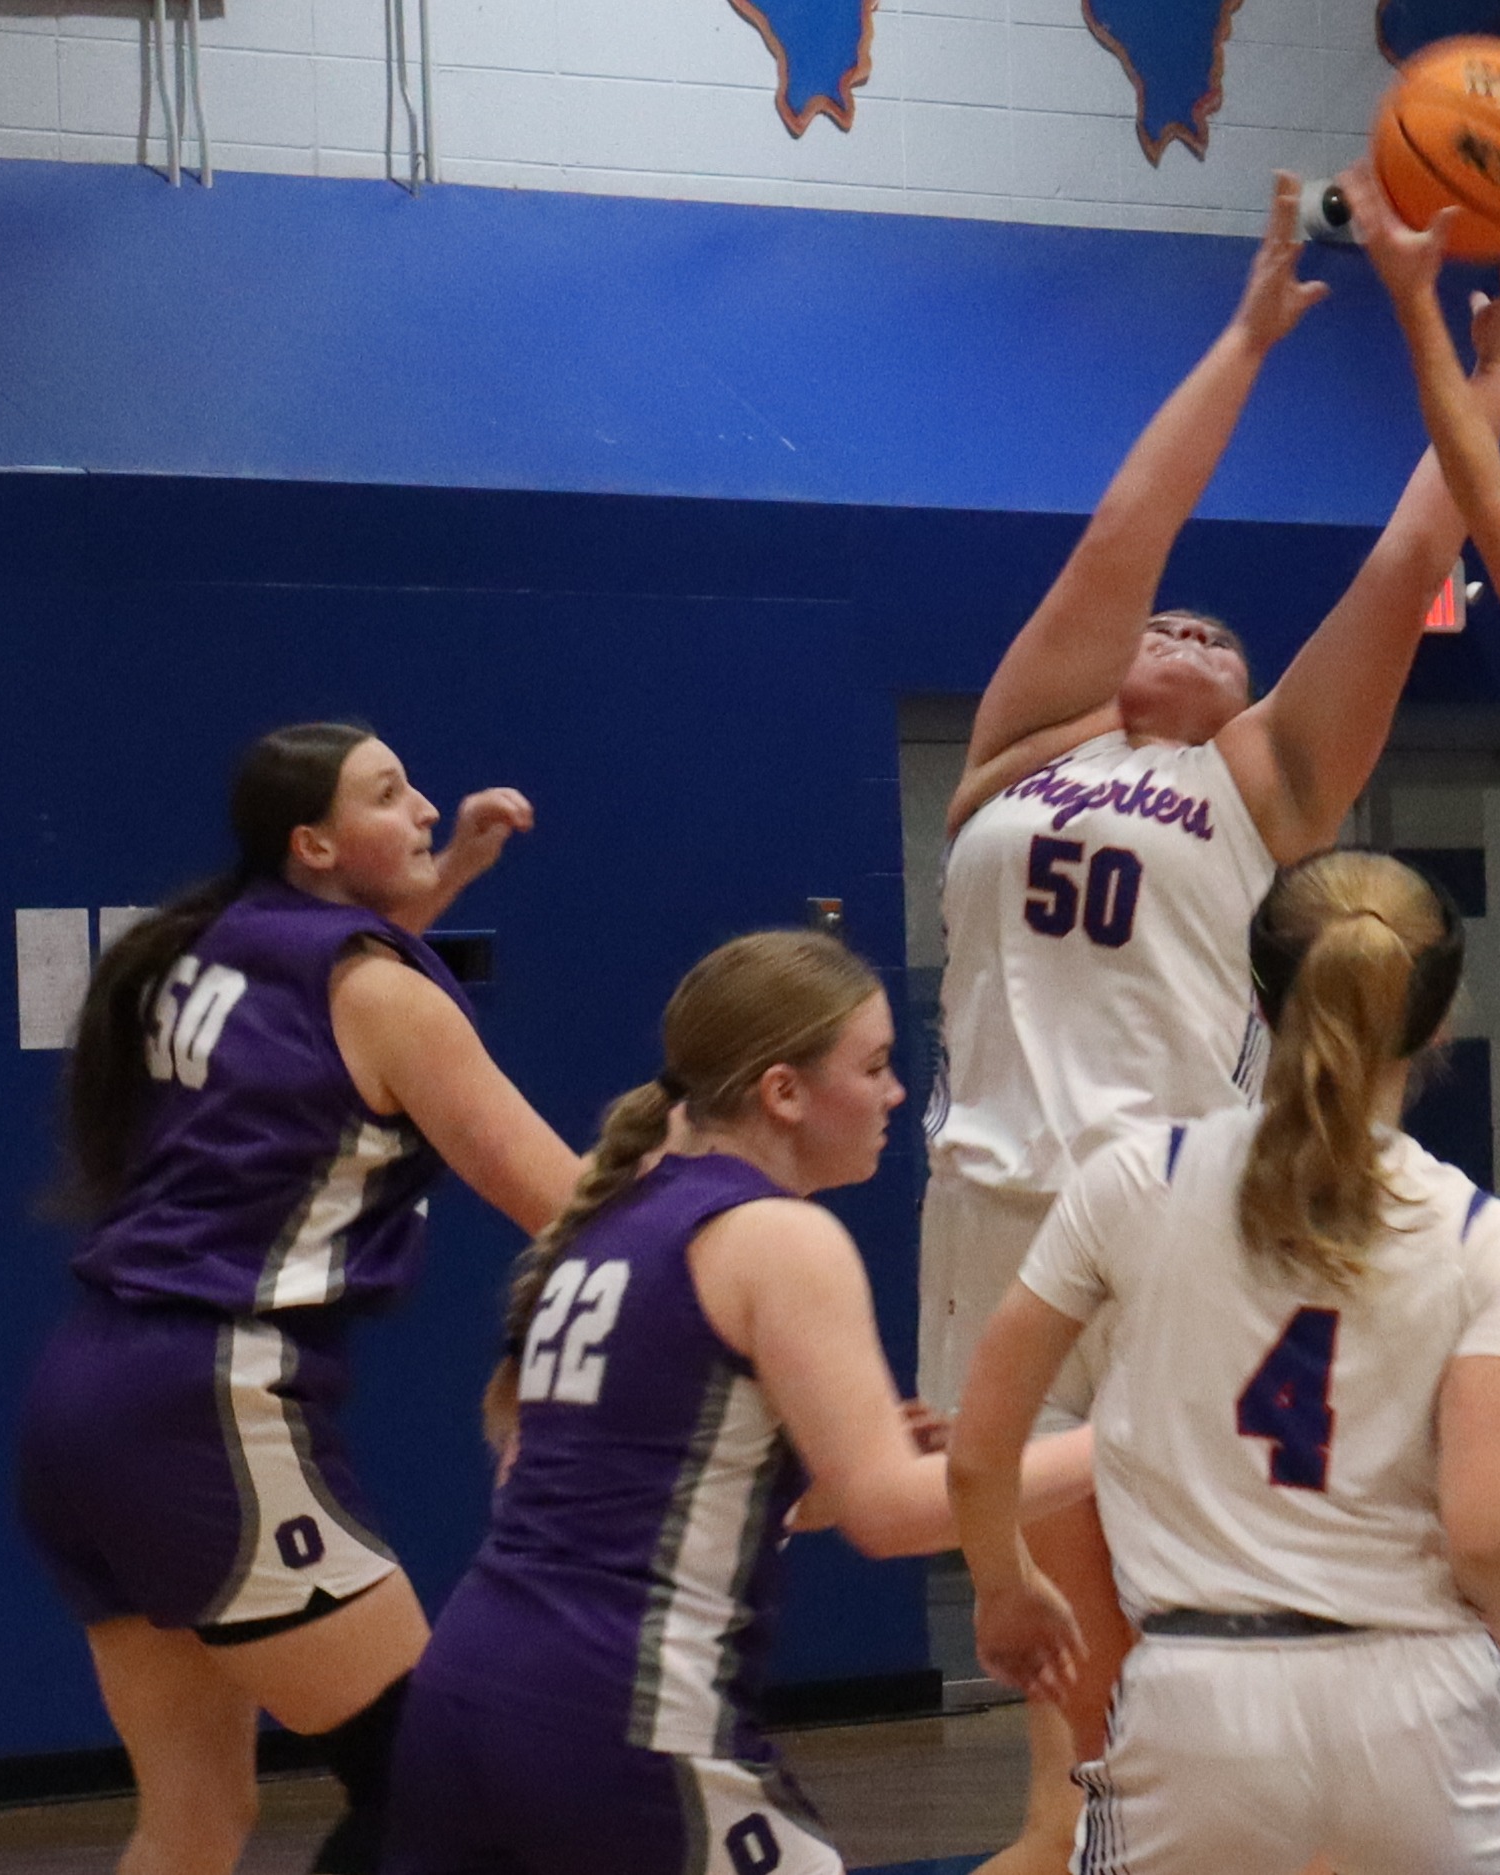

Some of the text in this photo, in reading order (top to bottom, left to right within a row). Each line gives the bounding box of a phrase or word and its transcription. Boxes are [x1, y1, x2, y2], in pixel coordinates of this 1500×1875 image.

[1024, 834, 1143, 948] 50
[144, 955, 248, 1090] 50
[519, 1259, 630, 1405] 22
[1235, 1305, 1339, 1491] 4
[274, 1514, 326, 1570] O
[725, 1812, 781, 1875] O
